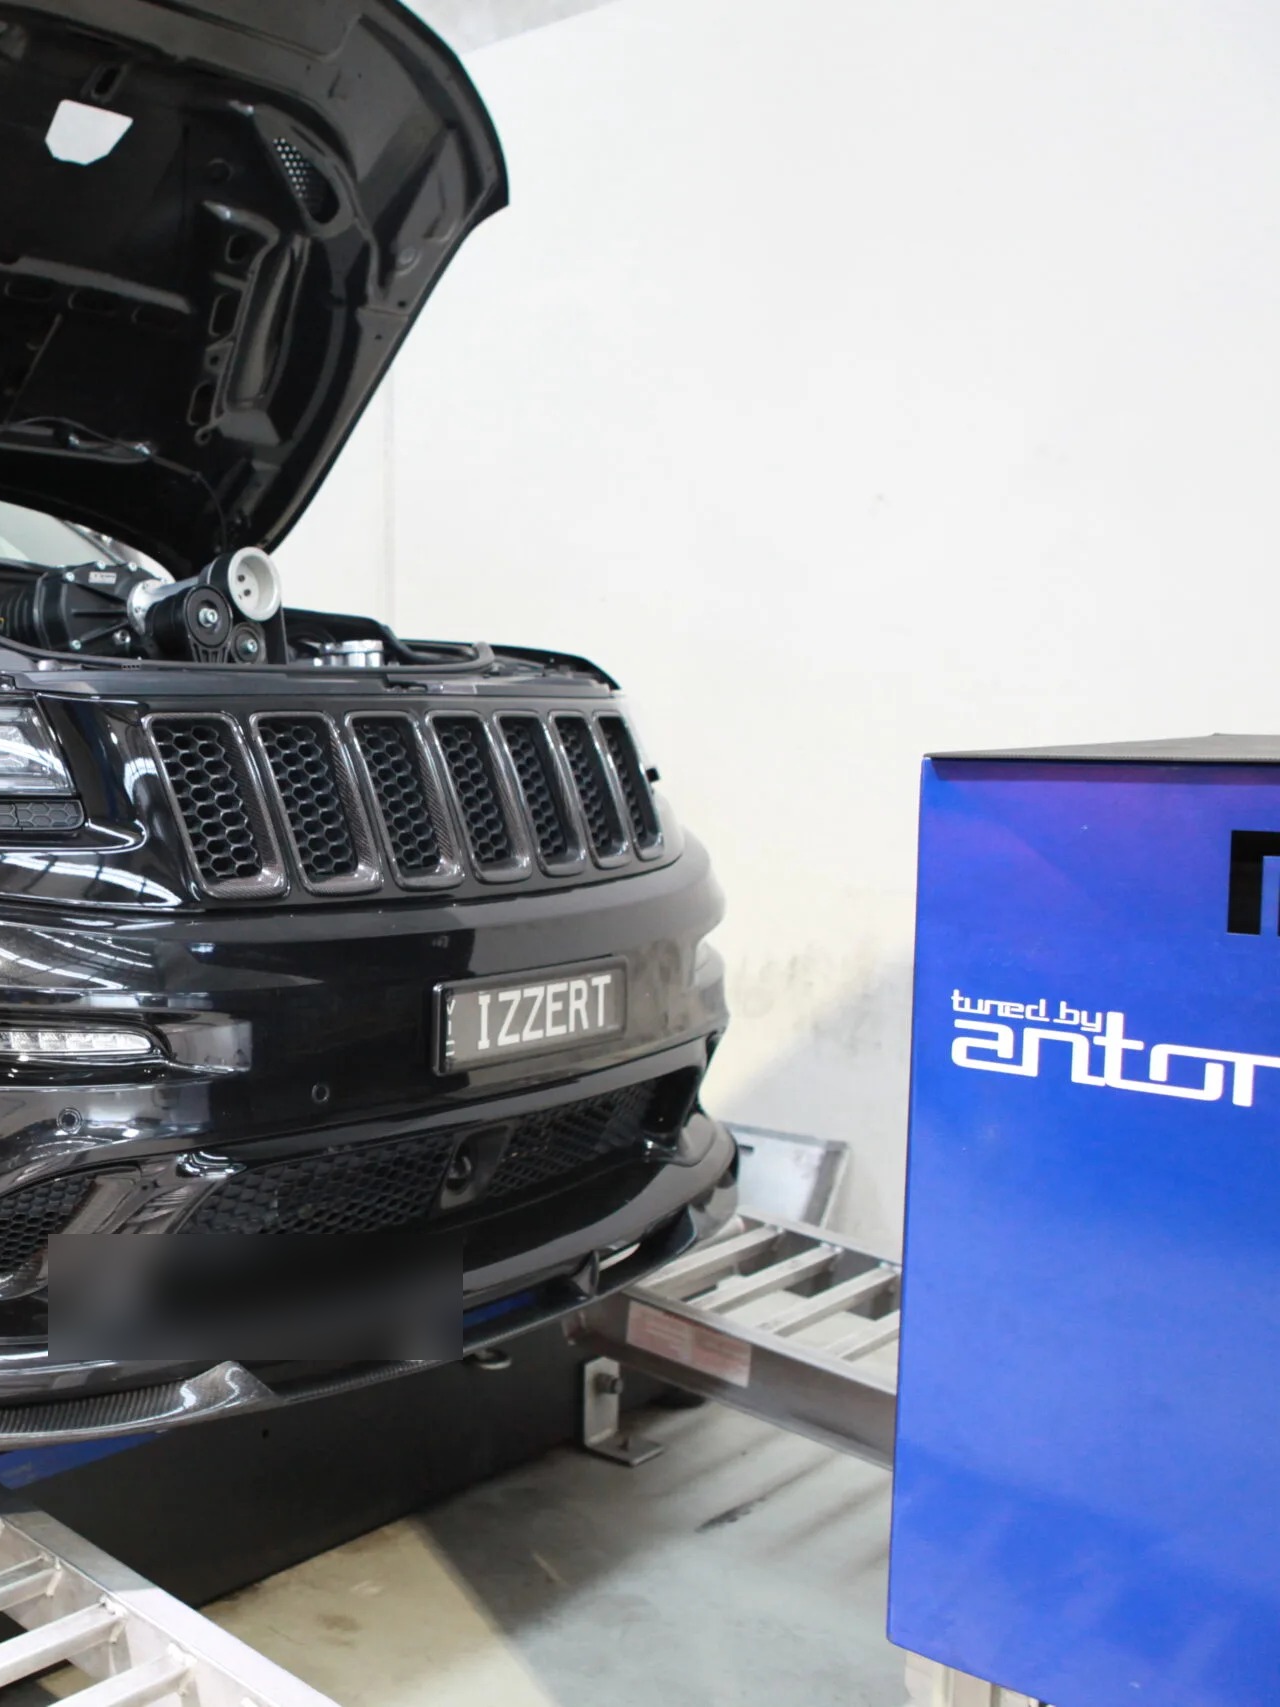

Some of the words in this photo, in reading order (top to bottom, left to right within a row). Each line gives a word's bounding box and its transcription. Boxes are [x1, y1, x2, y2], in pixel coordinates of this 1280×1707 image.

[477, 974, 612, 1050] IZZERT
[951, 988, 1050, 1023] tuned
[1053, 1001, 1102, 1033] by
